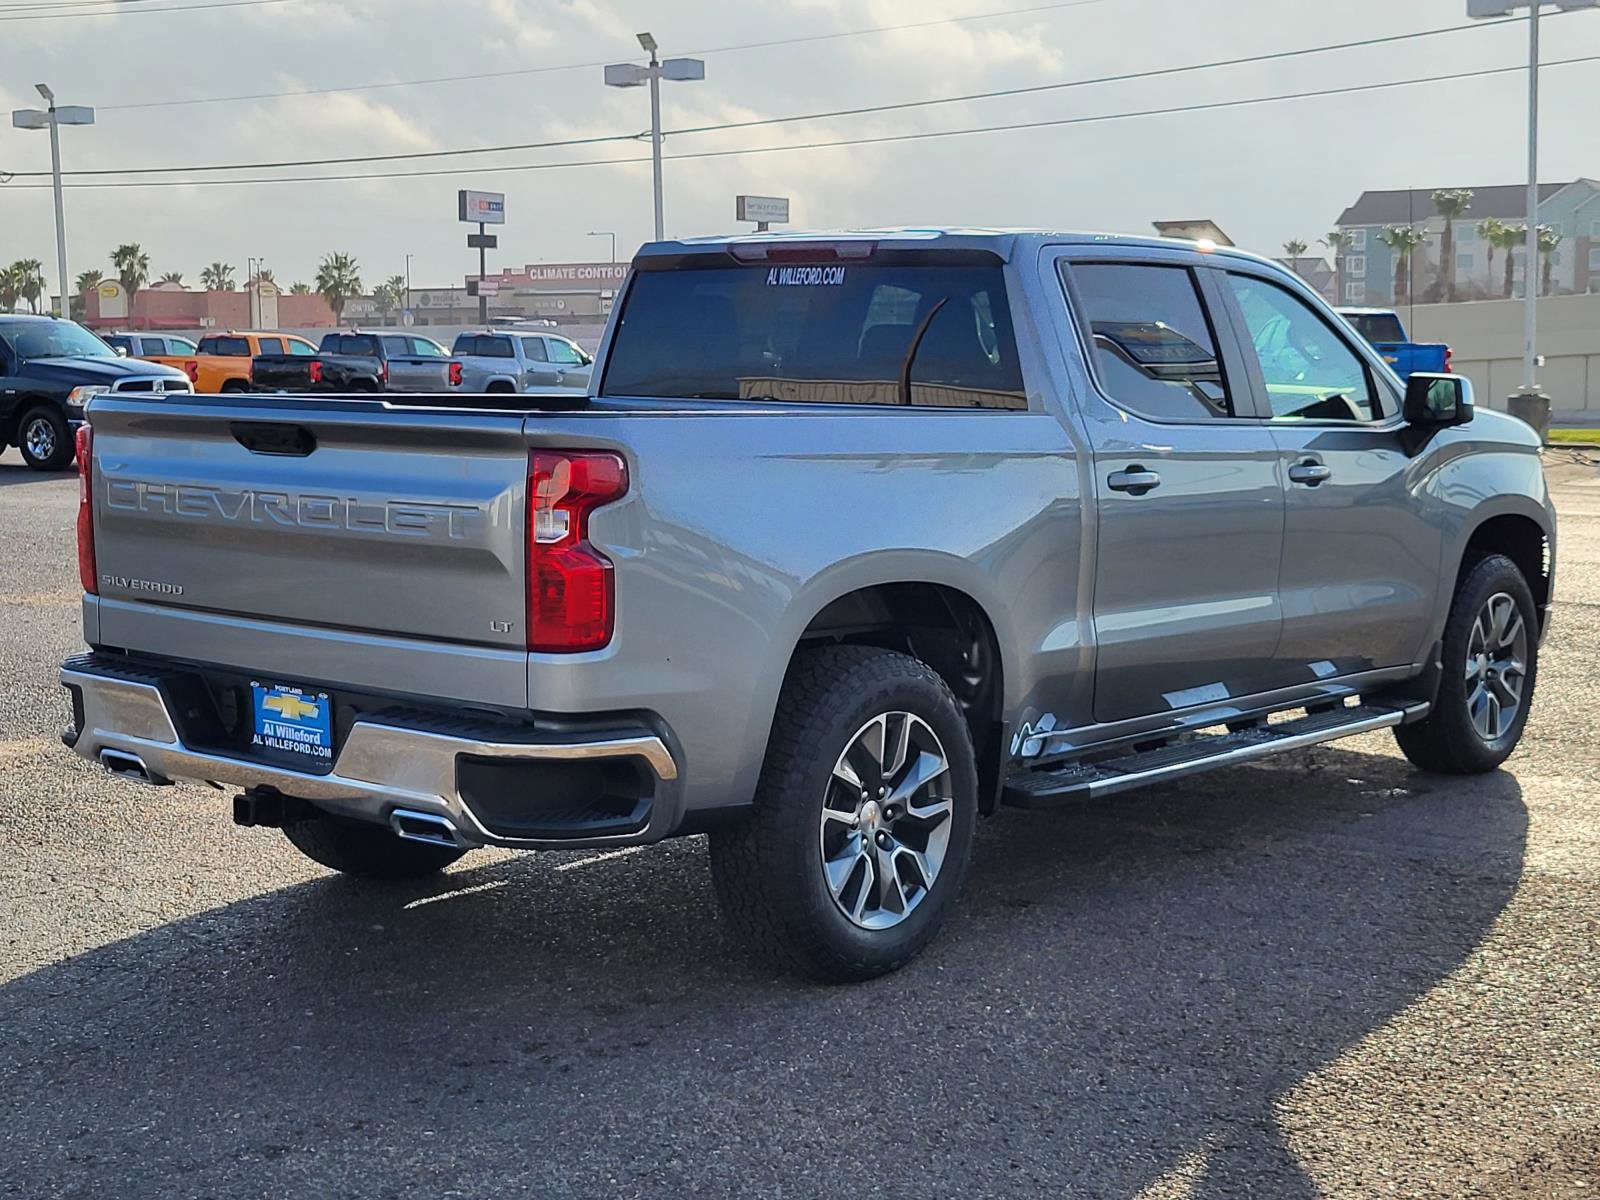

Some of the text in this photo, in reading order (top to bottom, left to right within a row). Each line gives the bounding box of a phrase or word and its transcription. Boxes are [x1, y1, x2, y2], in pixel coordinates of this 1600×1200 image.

[530, 267, 576, 280] CLIMATE
[767, 267, 845, 285] AL WILLEFORD.COM
[106, 479, 480, 539] CHEVROLET
[102, 574, 184, 595] SILVERADO
[490, 620, 512, 632] LT
[275, 684, 302, 695] PORTLAND
[263, 723, 321, 745] Al Willeford
[253, 734, 332, 758] AL WILLEFORD.COM
